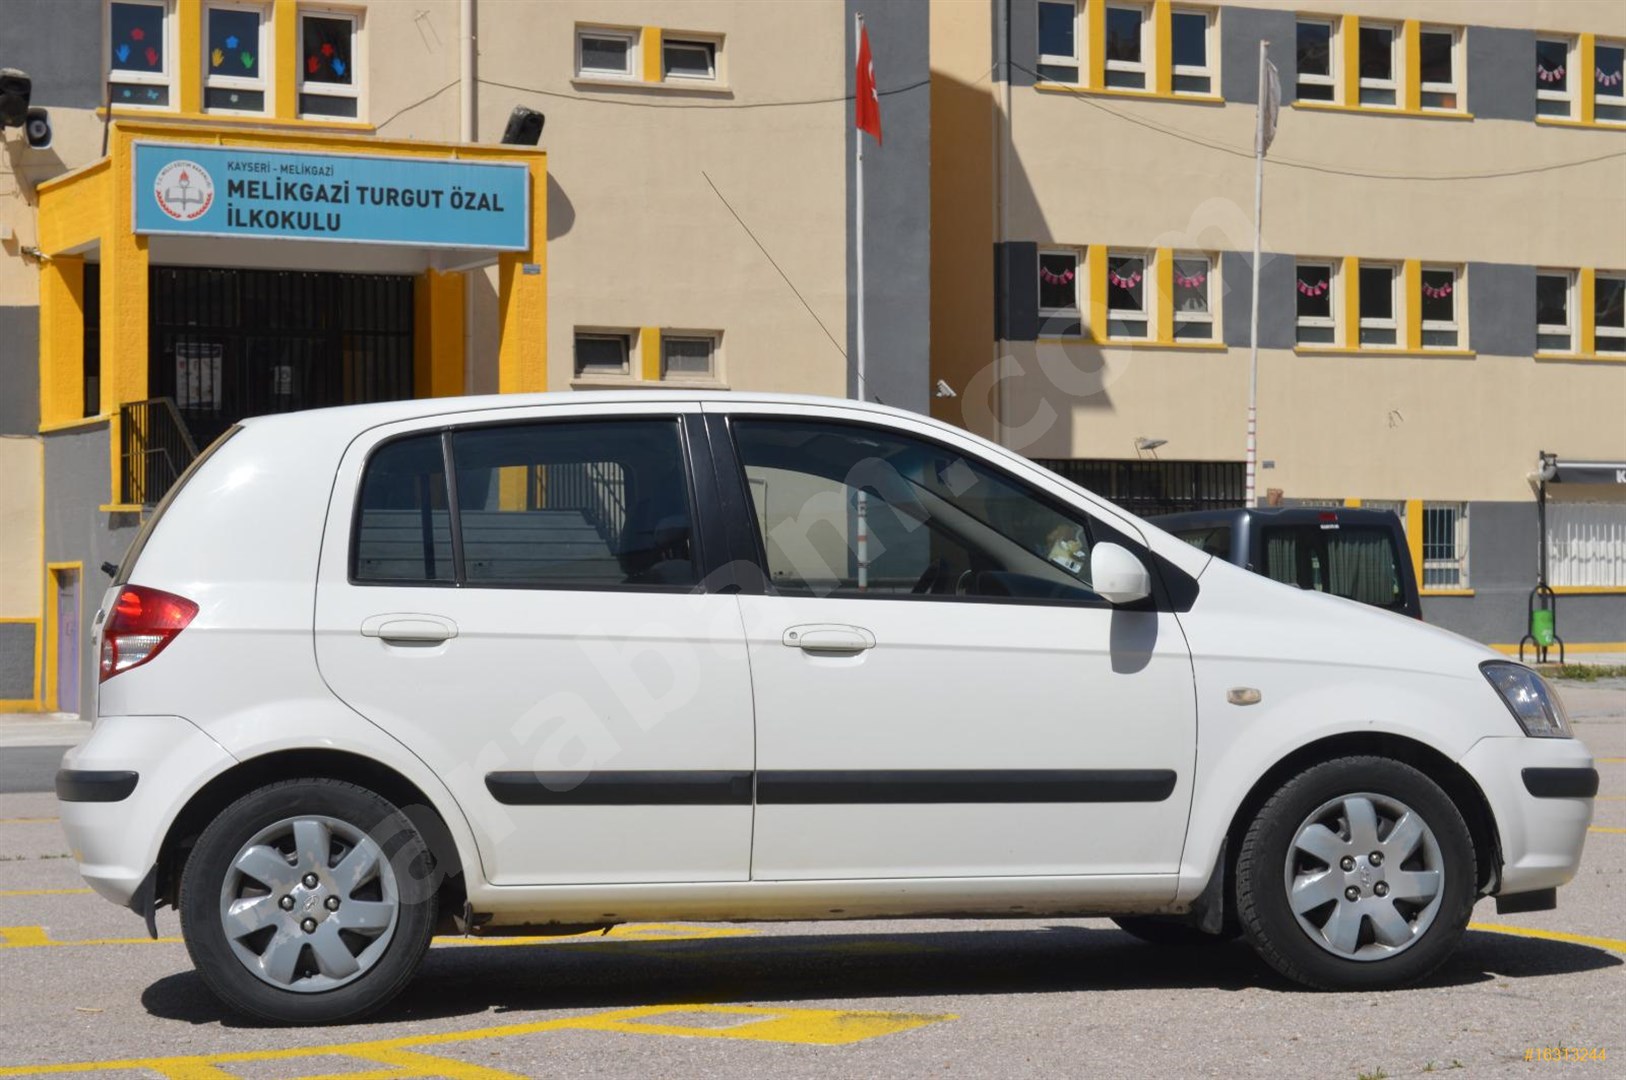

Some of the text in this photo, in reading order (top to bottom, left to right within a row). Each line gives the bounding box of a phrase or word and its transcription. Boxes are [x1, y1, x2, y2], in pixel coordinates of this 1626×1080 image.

[227, 161, 271, 173] KAYSERİ
[280, 164, 334, 176] MELİKGAZİ
[227, 177, 504, 212] MELİKGAZİ TURGUT ÖZAL
[227, 203, 341, 231] İLKOKULU
